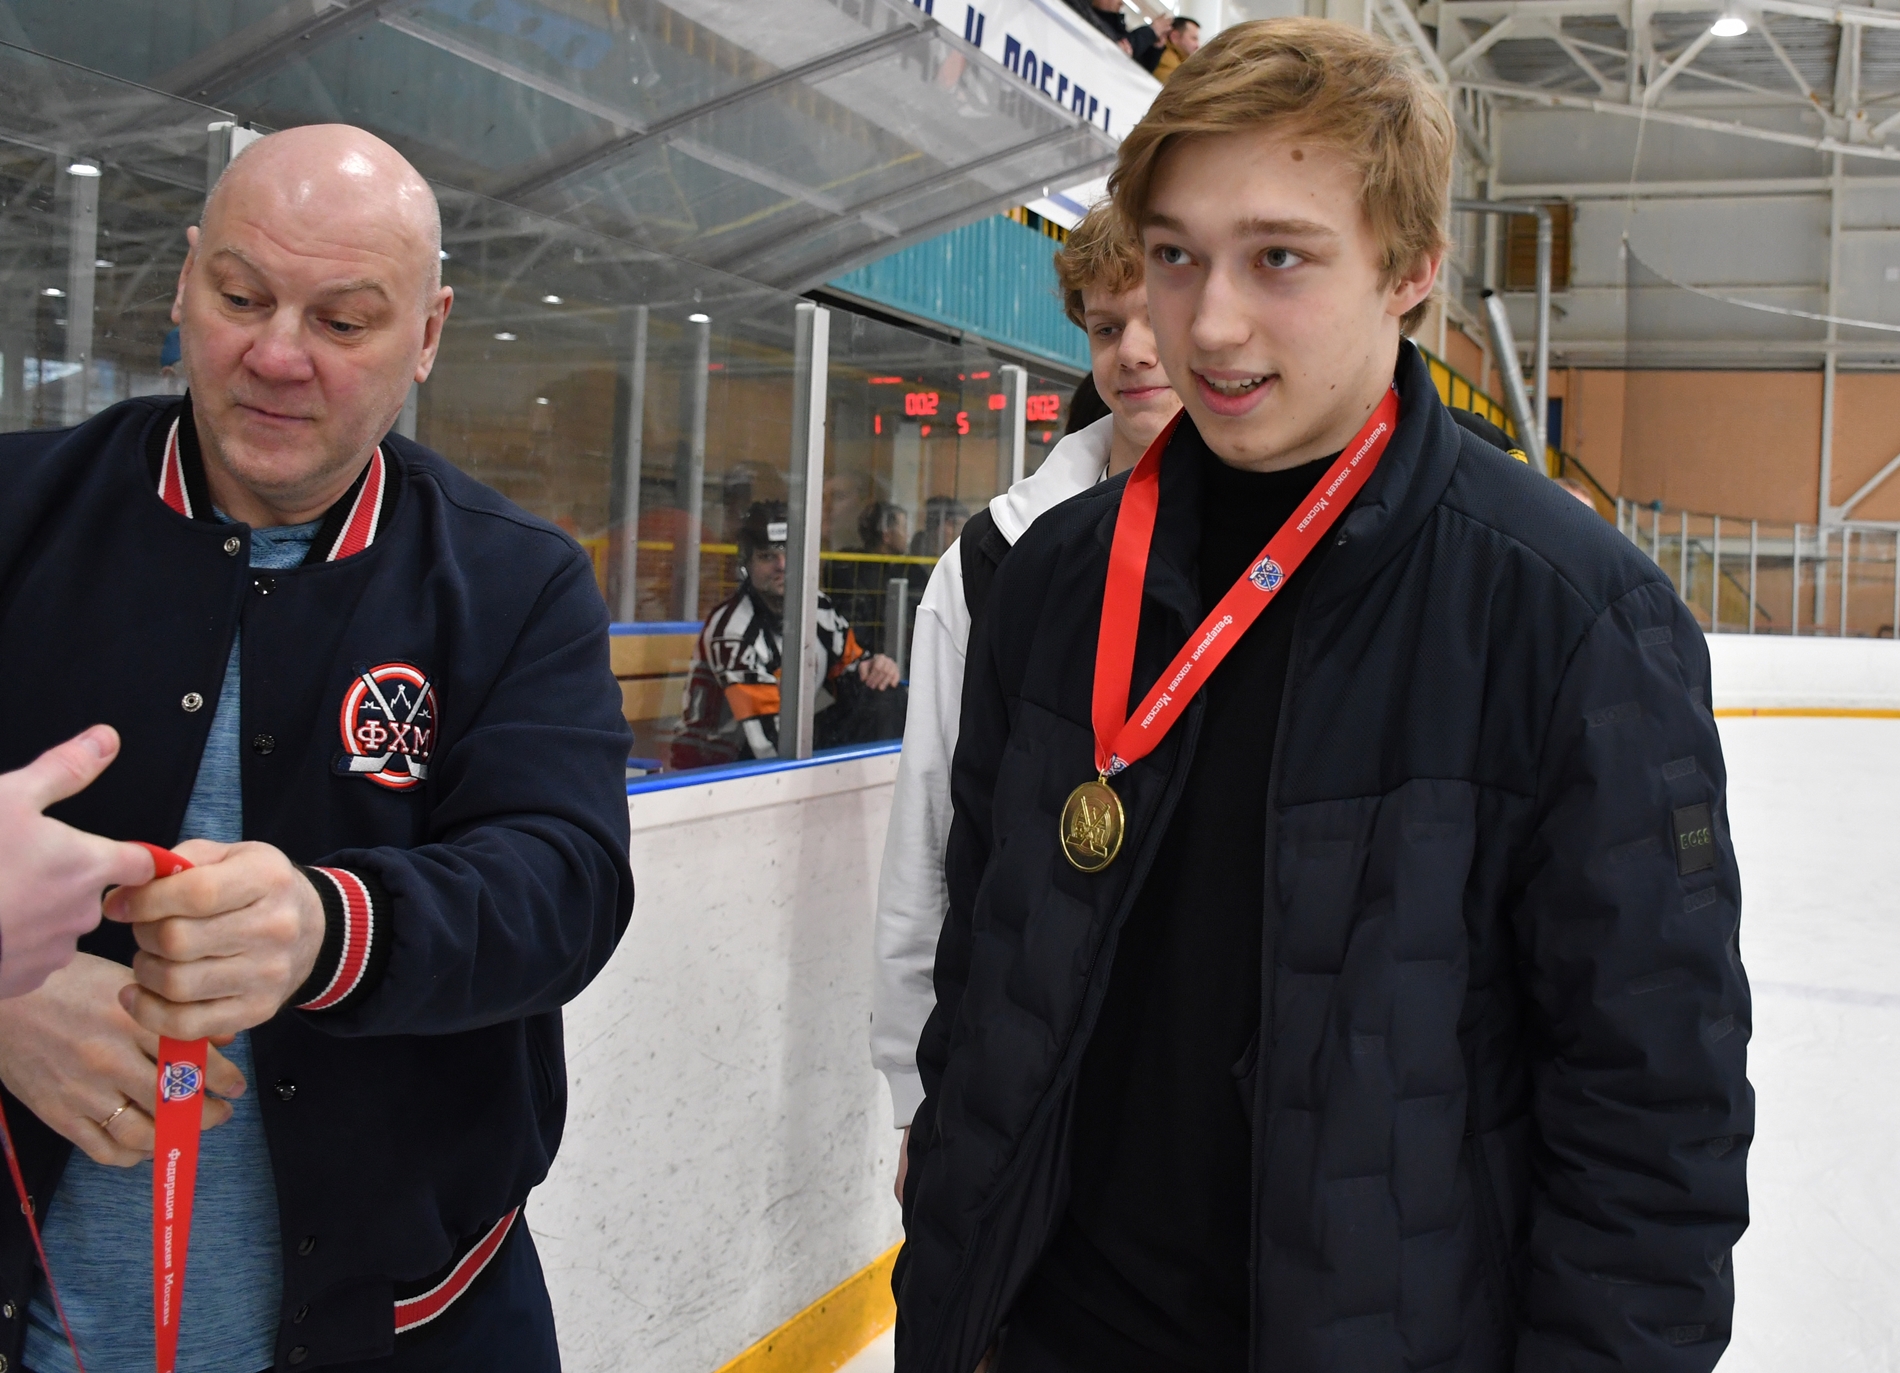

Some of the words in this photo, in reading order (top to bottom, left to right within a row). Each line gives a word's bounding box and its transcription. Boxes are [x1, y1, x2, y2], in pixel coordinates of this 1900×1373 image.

[1350, 422, 1387, 467] Федерация
[1326, 467, 1351, 497] хоккея
[1297, 497, 1329, 533] Москвы
[712, 641, 757, 672] 174
[1191, 614, 1233, 661] Федерация
[1168, 661, 1193, 692] хоккея
[1140, 692, 1172, 729] Москвы
[355, 719, 431, 760] ФХМ
[1680, 827, 1711, 850] BOSS
[164, 1148, 181, 1220] Федерация
[164, 1224, 173, 1269] хоккея
[163, 1272, 174, 1327] Москвы
